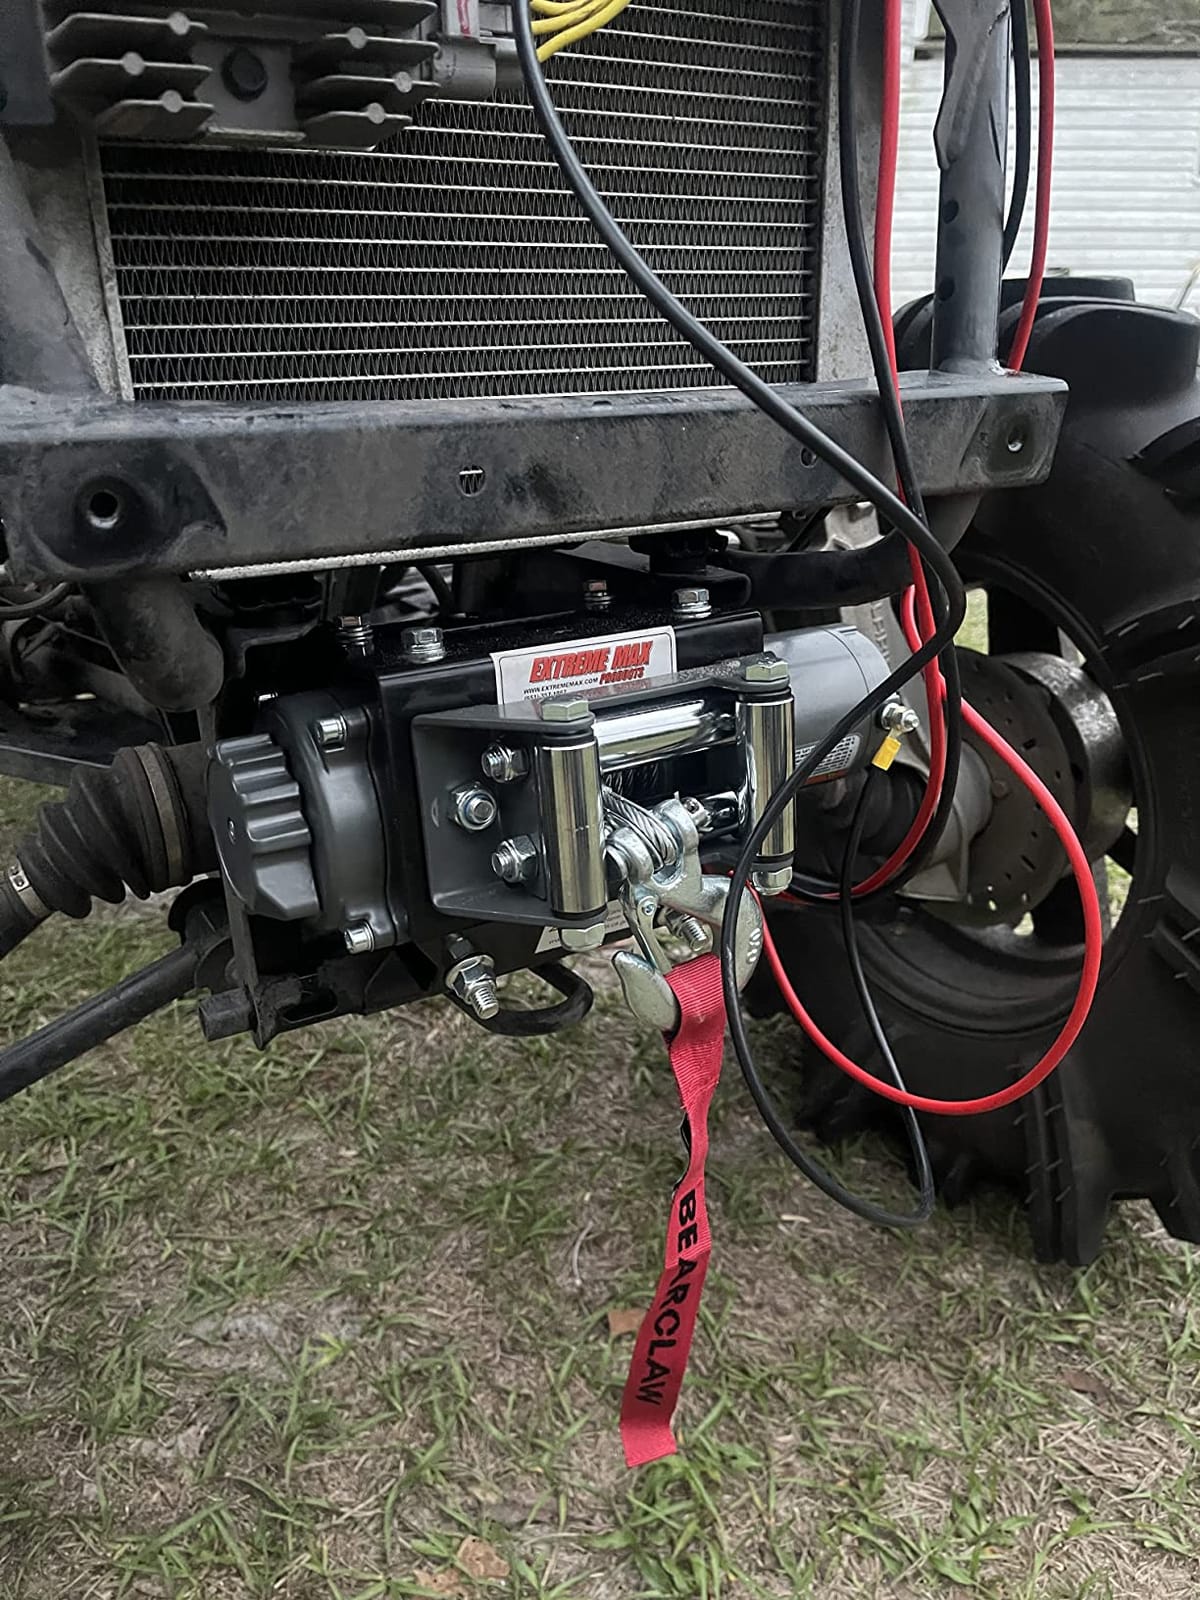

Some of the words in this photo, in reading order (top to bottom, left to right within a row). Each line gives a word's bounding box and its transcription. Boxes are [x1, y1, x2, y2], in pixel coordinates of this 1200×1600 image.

[529, 648, 610, 683] EXTREME
[611, 640, 653, 670] MAX
[600, 667, 645, 685] PRODUCTS
